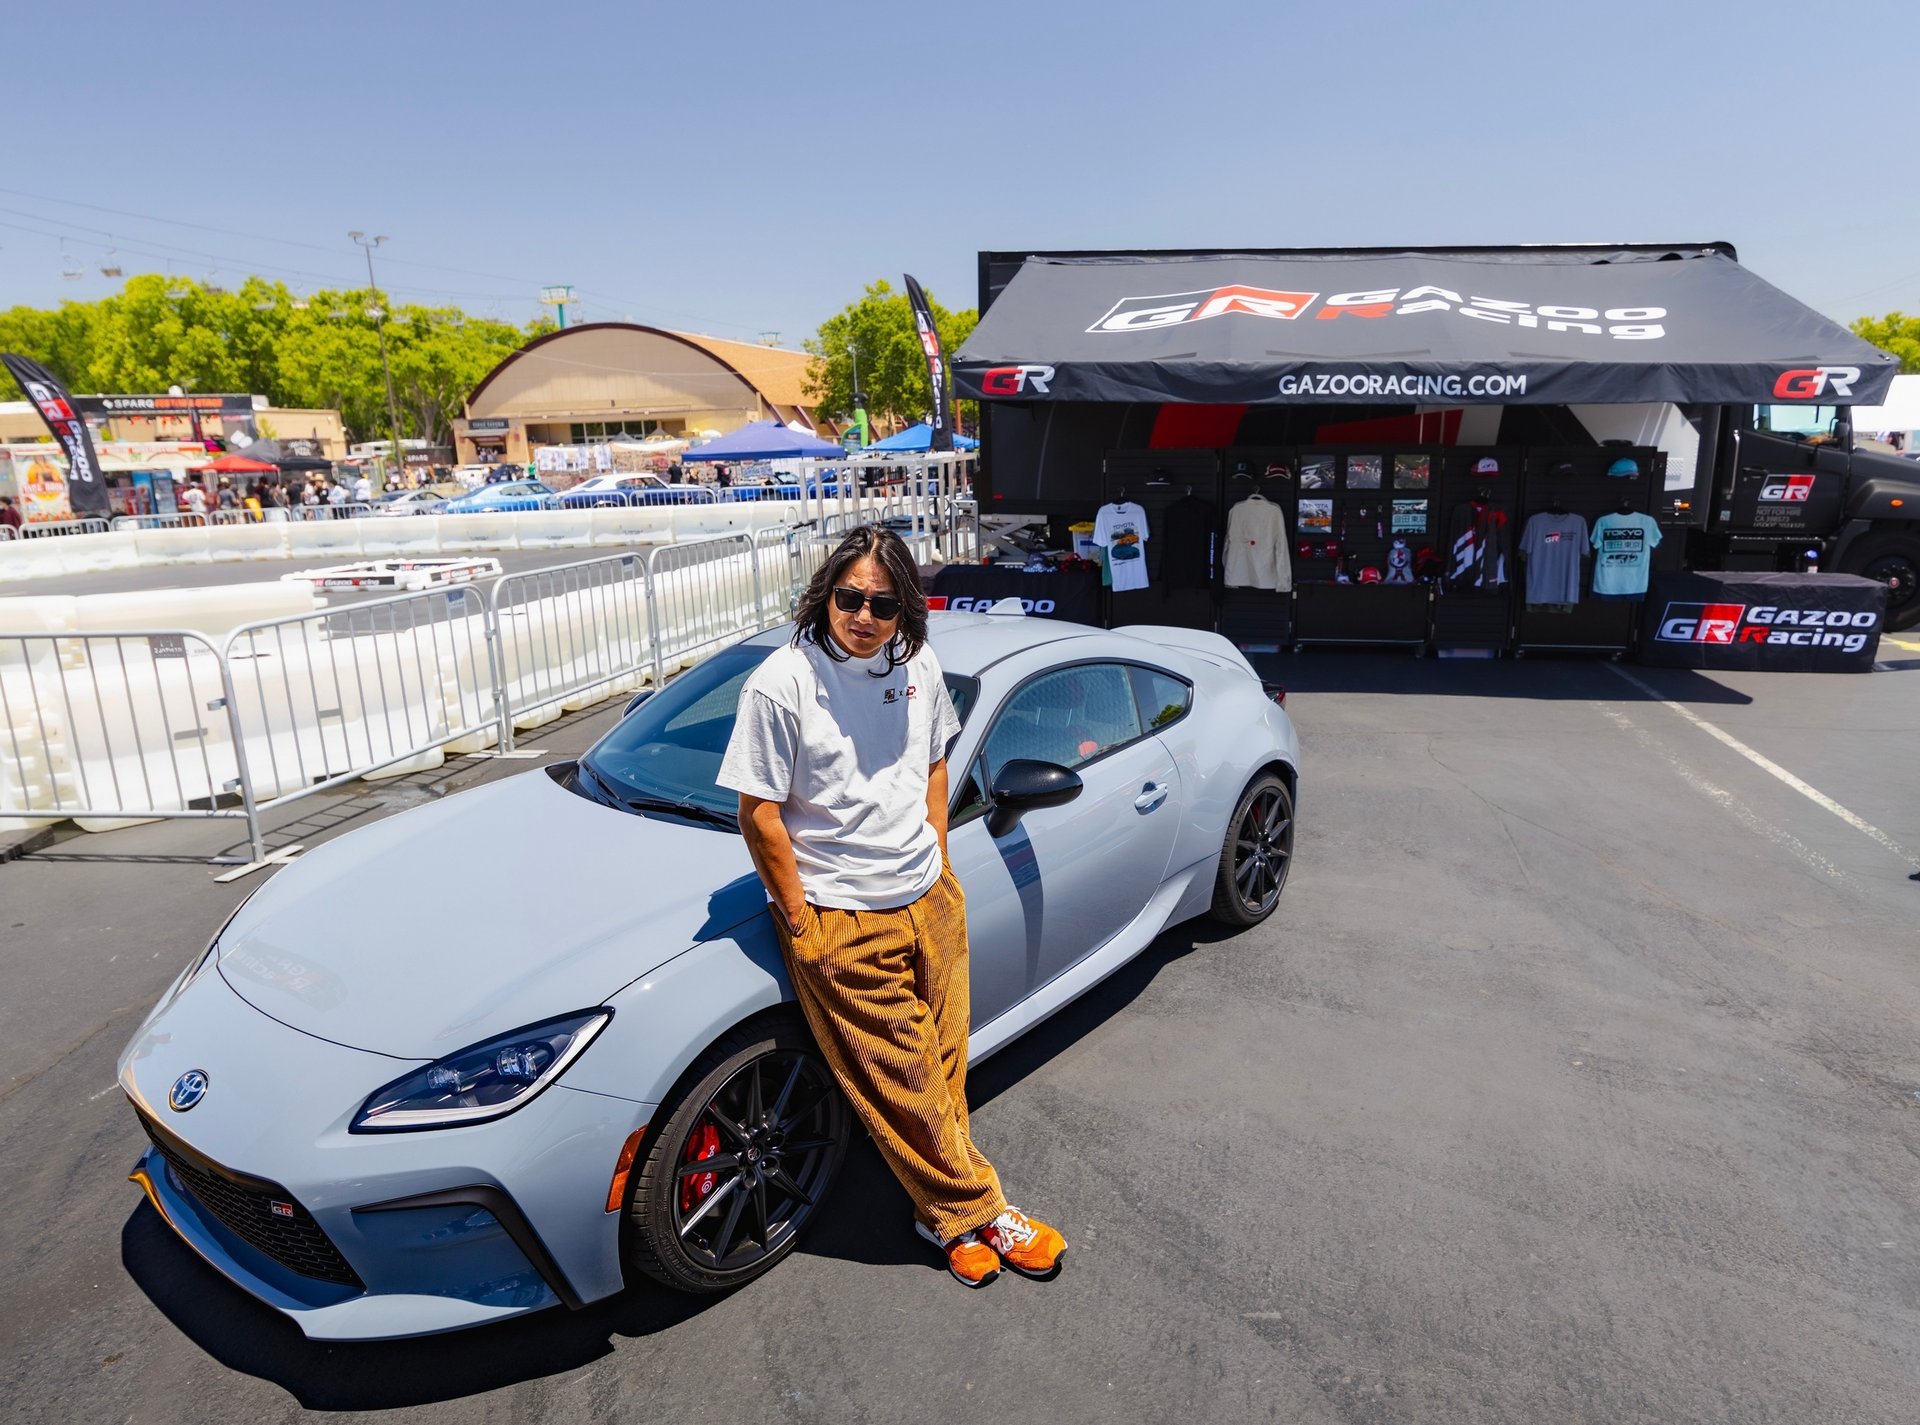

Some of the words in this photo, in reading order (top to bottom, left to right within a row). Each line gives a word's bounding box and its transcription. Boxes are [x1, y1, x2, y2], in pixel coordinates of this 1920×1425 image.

[1102, 294, 1296, 330] GR
[1326, 285, 1667, 321] GAZOO
[982, 364, 1056, 395] GR
[1278, 373, 1527, 397] GAZOORACING.COM
[1772, 366, 1861, 399] GR
[28, 383, 65, 421] GR
[1761, 484, 1810, 499] GR
[1604, 529, 1643, 537] TOKYO
[1661, 618, 1735, 641] GR
[1746, 606, 1877, 628] GAZOO
[1738, 626, 1868, 653] Racing
[273, 1205, 293, 1216] GR
